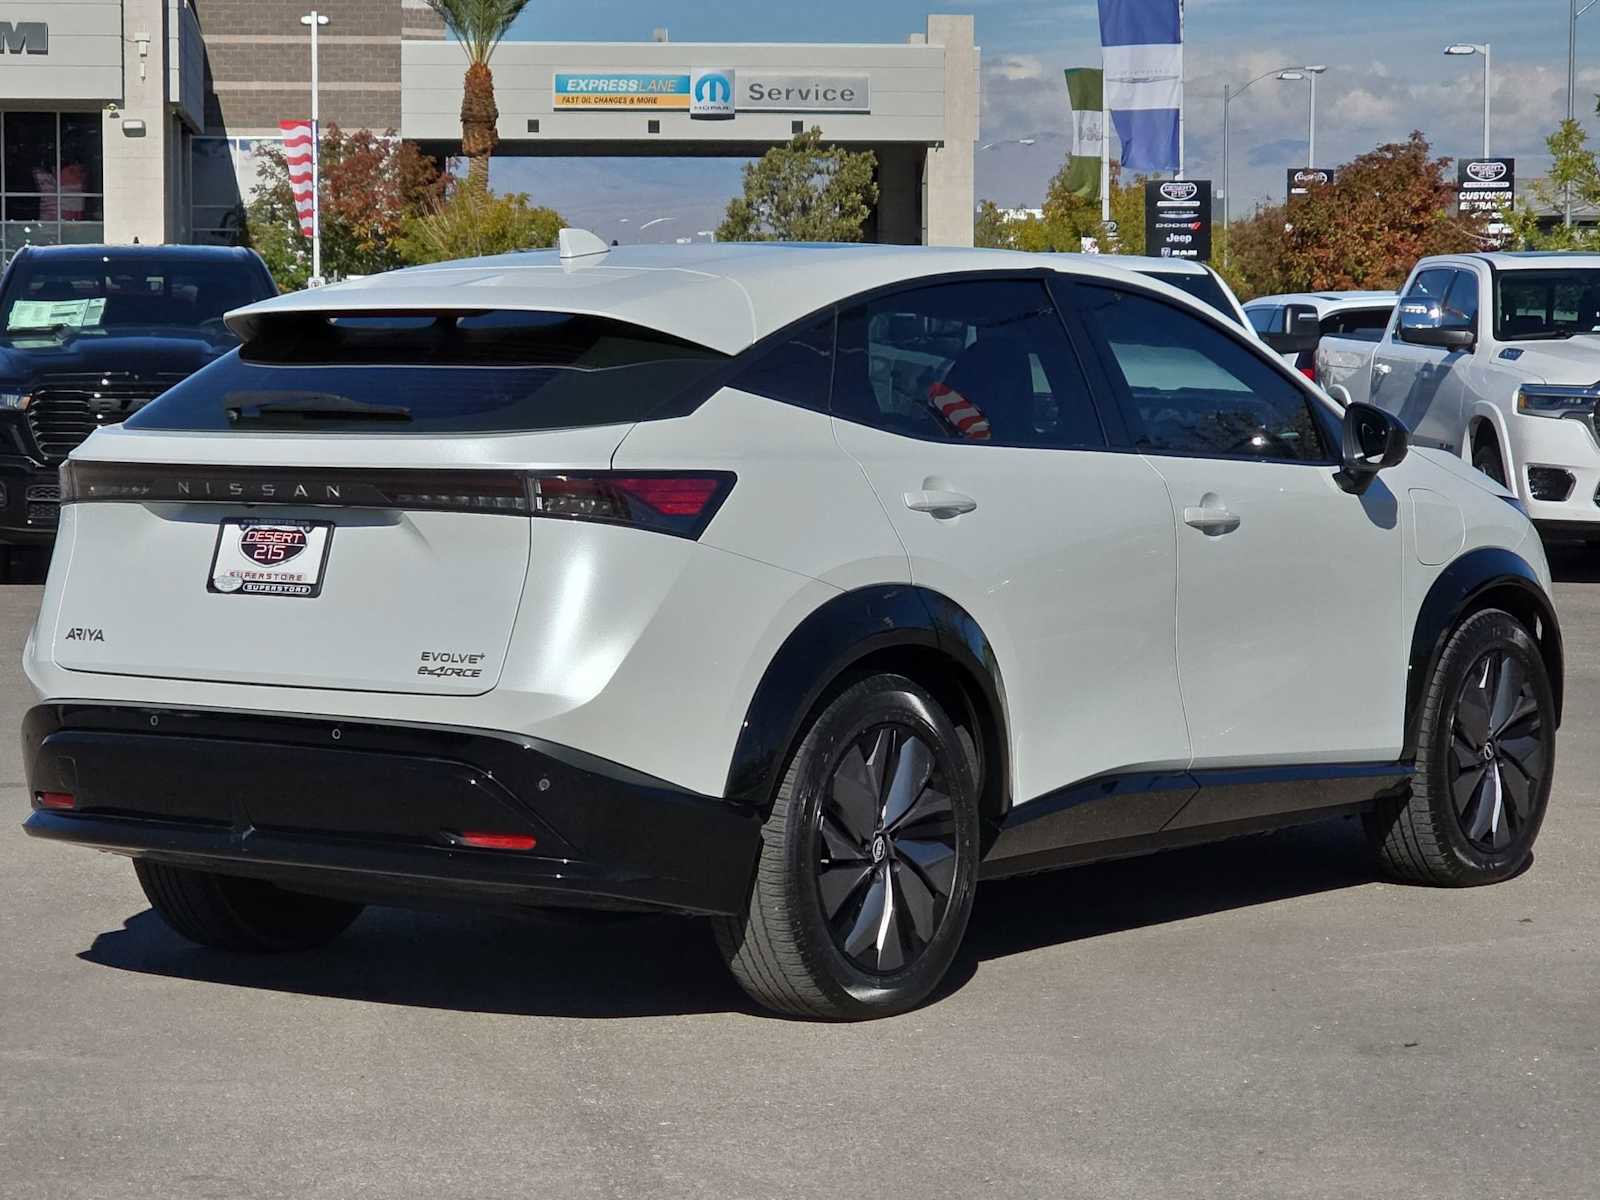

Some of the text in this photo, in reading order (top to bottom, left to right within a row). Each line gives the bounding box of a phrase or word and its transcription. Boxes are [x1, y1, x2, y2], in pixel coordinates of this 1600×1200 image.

[749, 83, 855, 102] Service
[561, 96, 579, 105] FAST
[581, 96, 592, 105] OIL
[593, 96, 628, 105] CHANGES
[636, 96, 658, 105] MORE
[1166, 233, 1193, 244] Jeep
[177, 480, 341, 498] NISSAN
[245, 530, 303, 544] DESERT
[253, 543, 286, 560] 215
[228, 571, 304, 582] SUPERSTORE
[247, 584, 307, 593] SUPERSTORE
[65, 627, 105, 642] ARIYA
